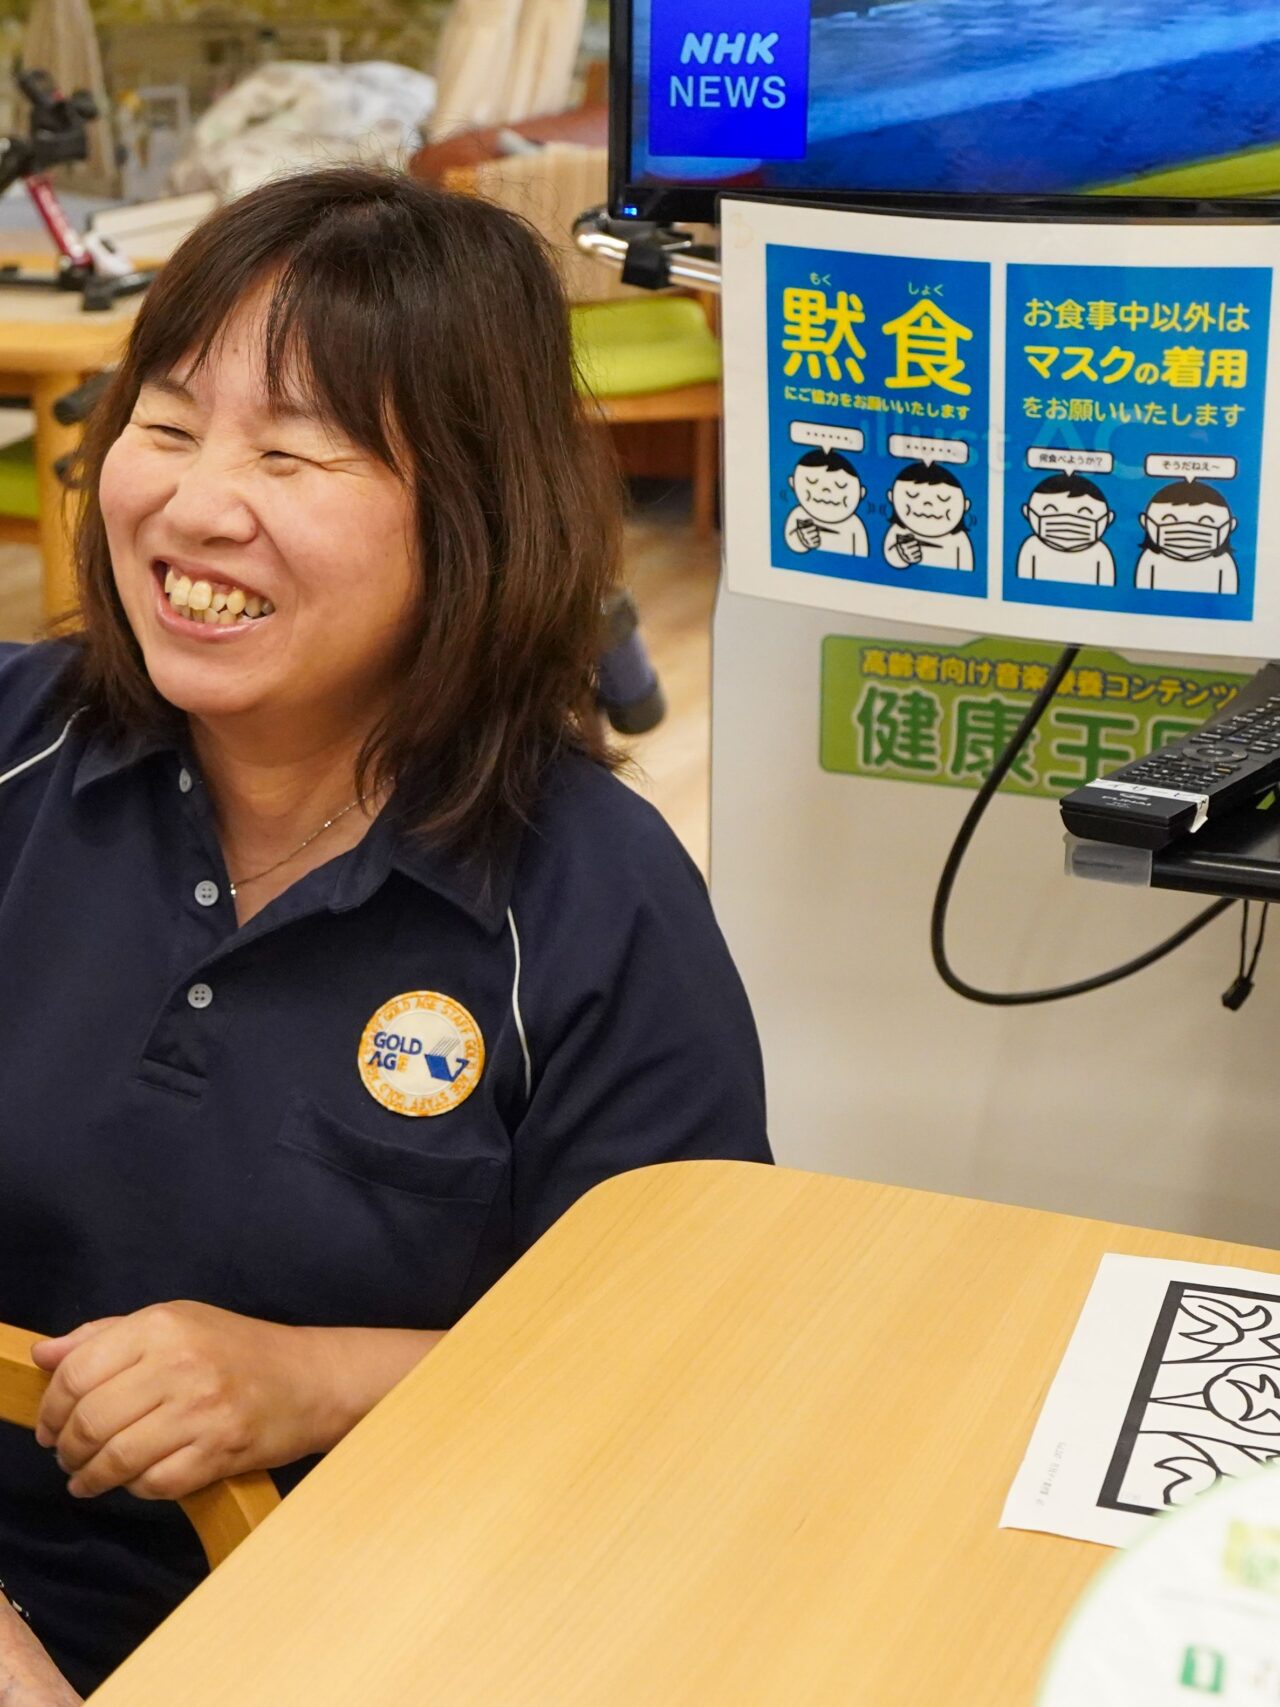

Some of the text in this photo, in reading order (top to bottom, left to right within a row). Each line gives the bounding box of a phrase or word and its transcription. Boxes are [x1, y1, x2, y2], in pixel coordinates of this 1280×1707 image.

[680, 32, 779, 64] NHK
[670, 75, 786, 109] NEWS
[810, 272, 944, 297] もく しょく
[1023, 298, 1250, 333] お食事中以外は
[782, 287, 973, 396] 黙食
[1023, 345, 1249, 389] マスクの着用
[784, 386, 971, 421] にご協力をお願いいたします
[1023, 396, 1246, 427] をお願いいたします
[1038, 453, 1103, 467] 何食べようか?
[857, 686, 1204, 789] 健康王
[373, 1031, 423, 1056] GOLD
[368, 1051, 410, 1073] AGE
